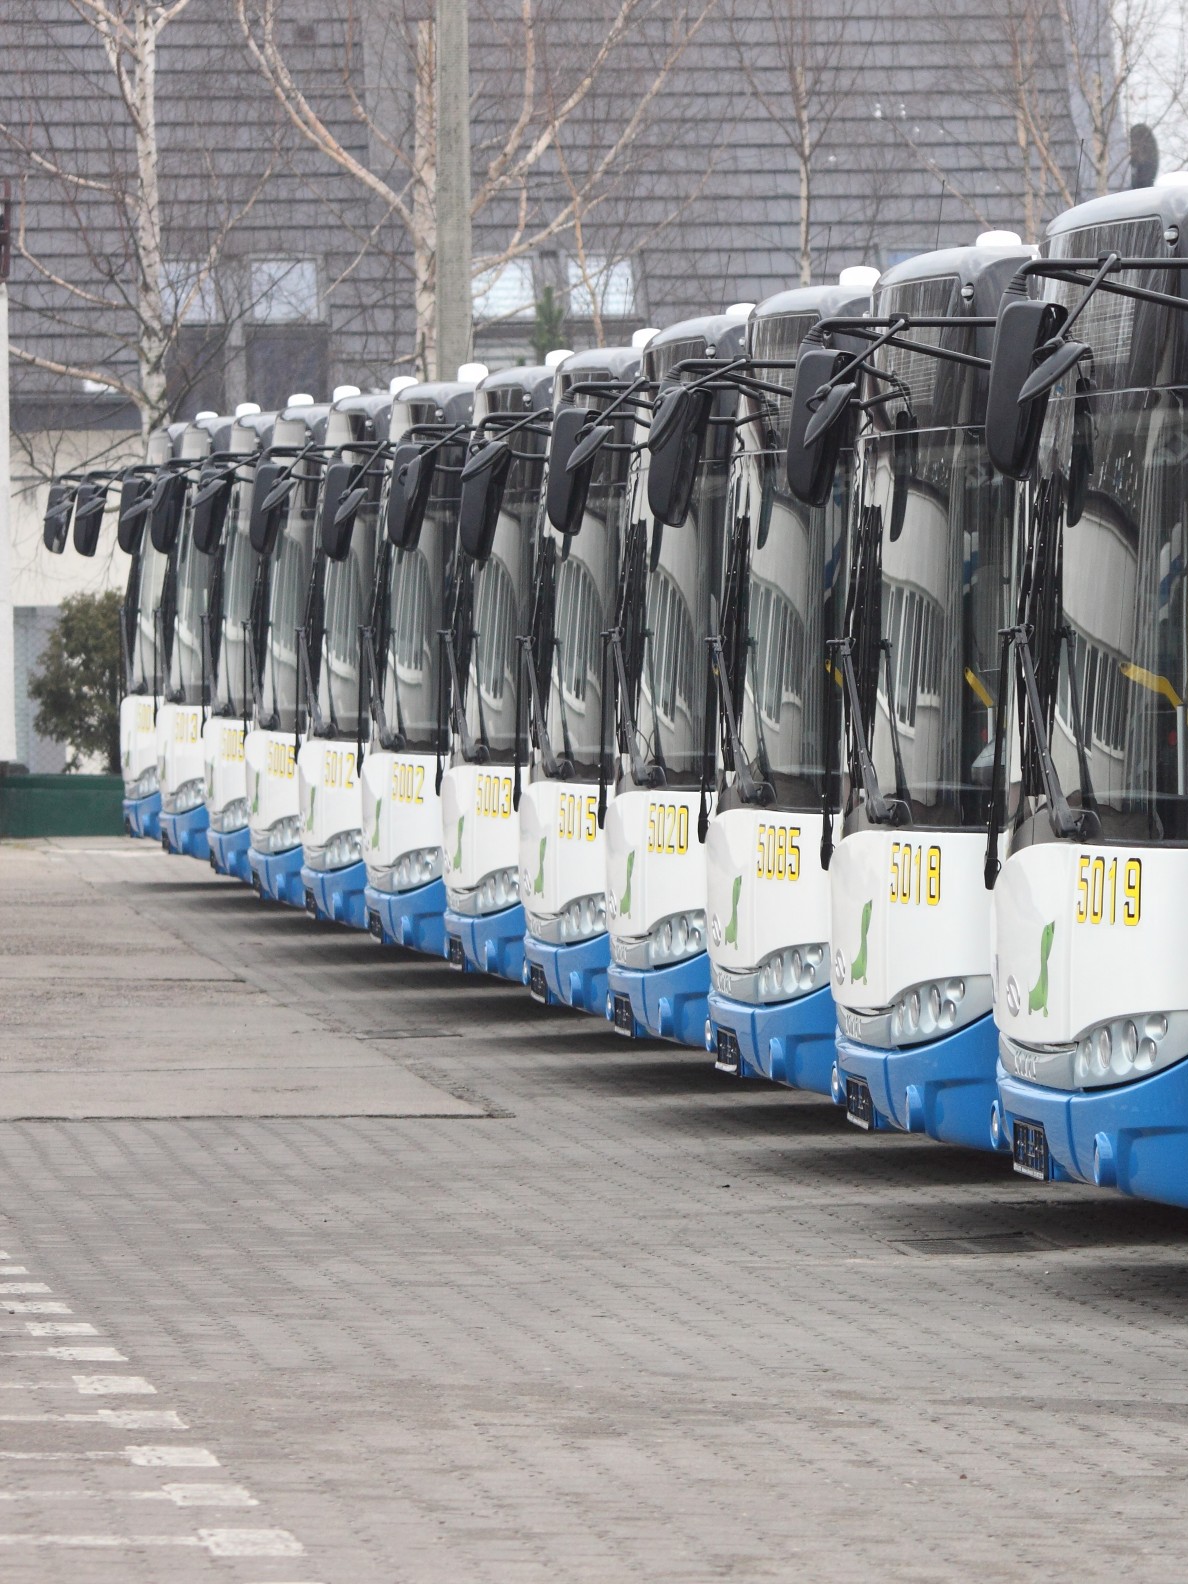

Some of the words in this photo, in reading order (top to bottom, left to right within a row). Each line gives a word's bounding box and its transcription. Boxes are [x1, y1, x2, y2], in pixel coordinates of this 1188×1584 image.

[174, 712, 198, 743] 5013
[267, 740, 296, 779] 5006
[325, 750, 356, 788] 5012
[392, 761, 425, 804] 5002
[476, 773, 512, 819] 5003
[559, 792, 597, 842] 5015
[648, 802, 689, 854] 5020
[756, 823, 801, 881] 5085
[889, 841, 942, 906] 5018
[1076, 854, 1142, 927] 5019
